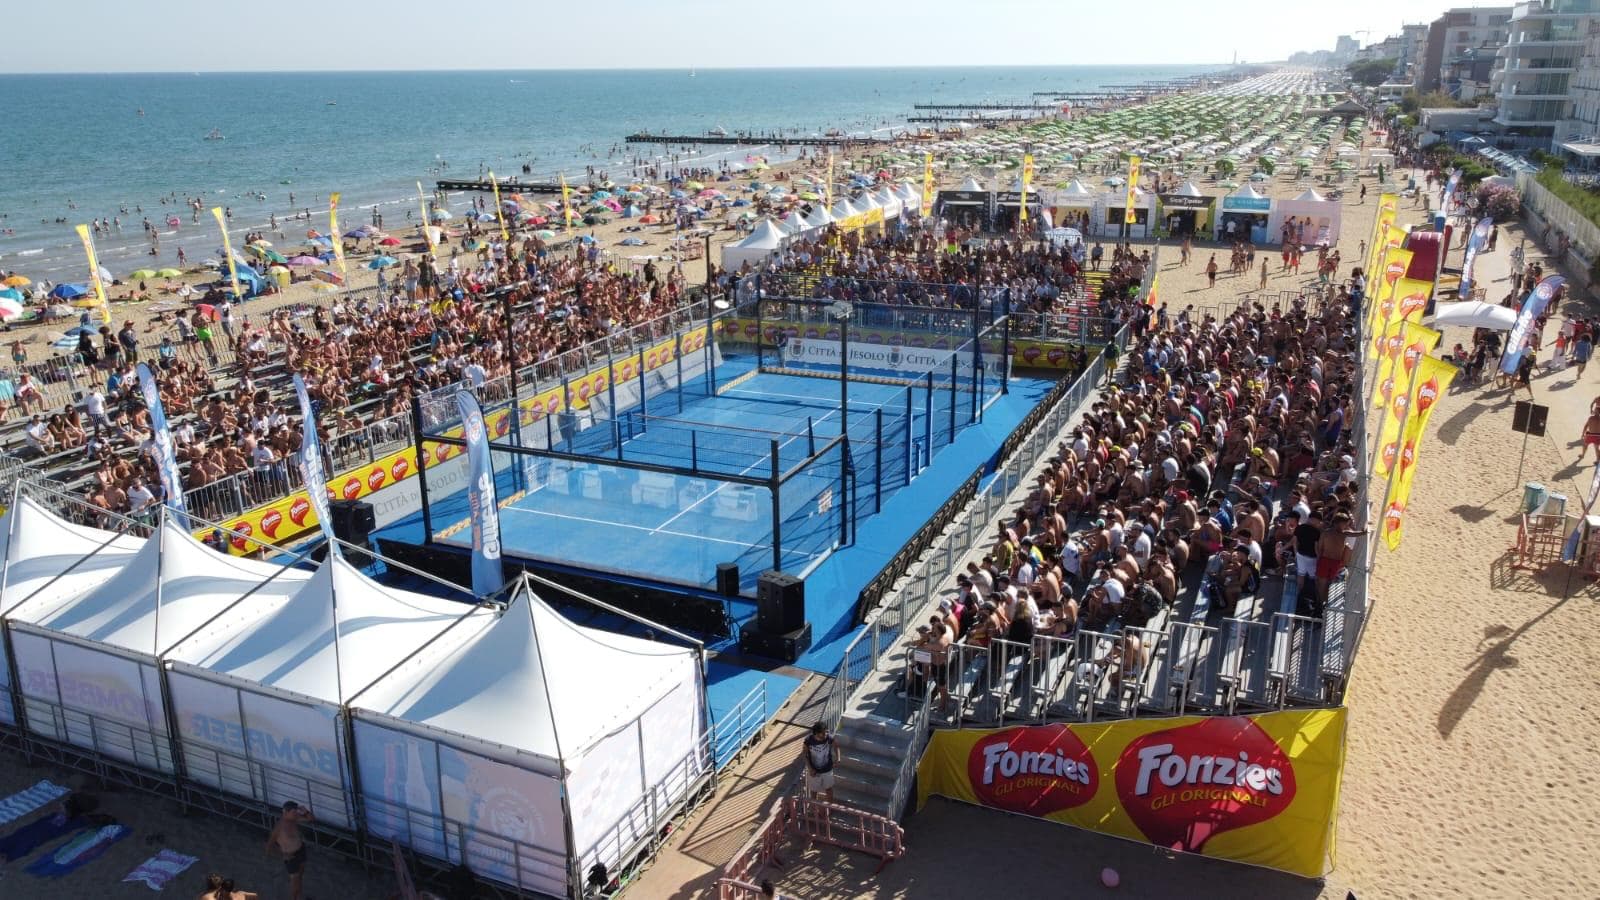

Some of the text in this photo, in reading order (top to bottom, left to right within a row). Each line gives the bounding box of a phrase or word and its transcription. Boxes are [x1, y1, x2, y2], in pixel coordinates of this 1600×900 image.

[983, 742, 1089, 784] Fonzies
[1135, 743, 1283, 796] Fonzies
[995, 777, 1080, 796] GLI ORIGINALI
[1151, 788, 1267, 810] GLI ORIGINALI
